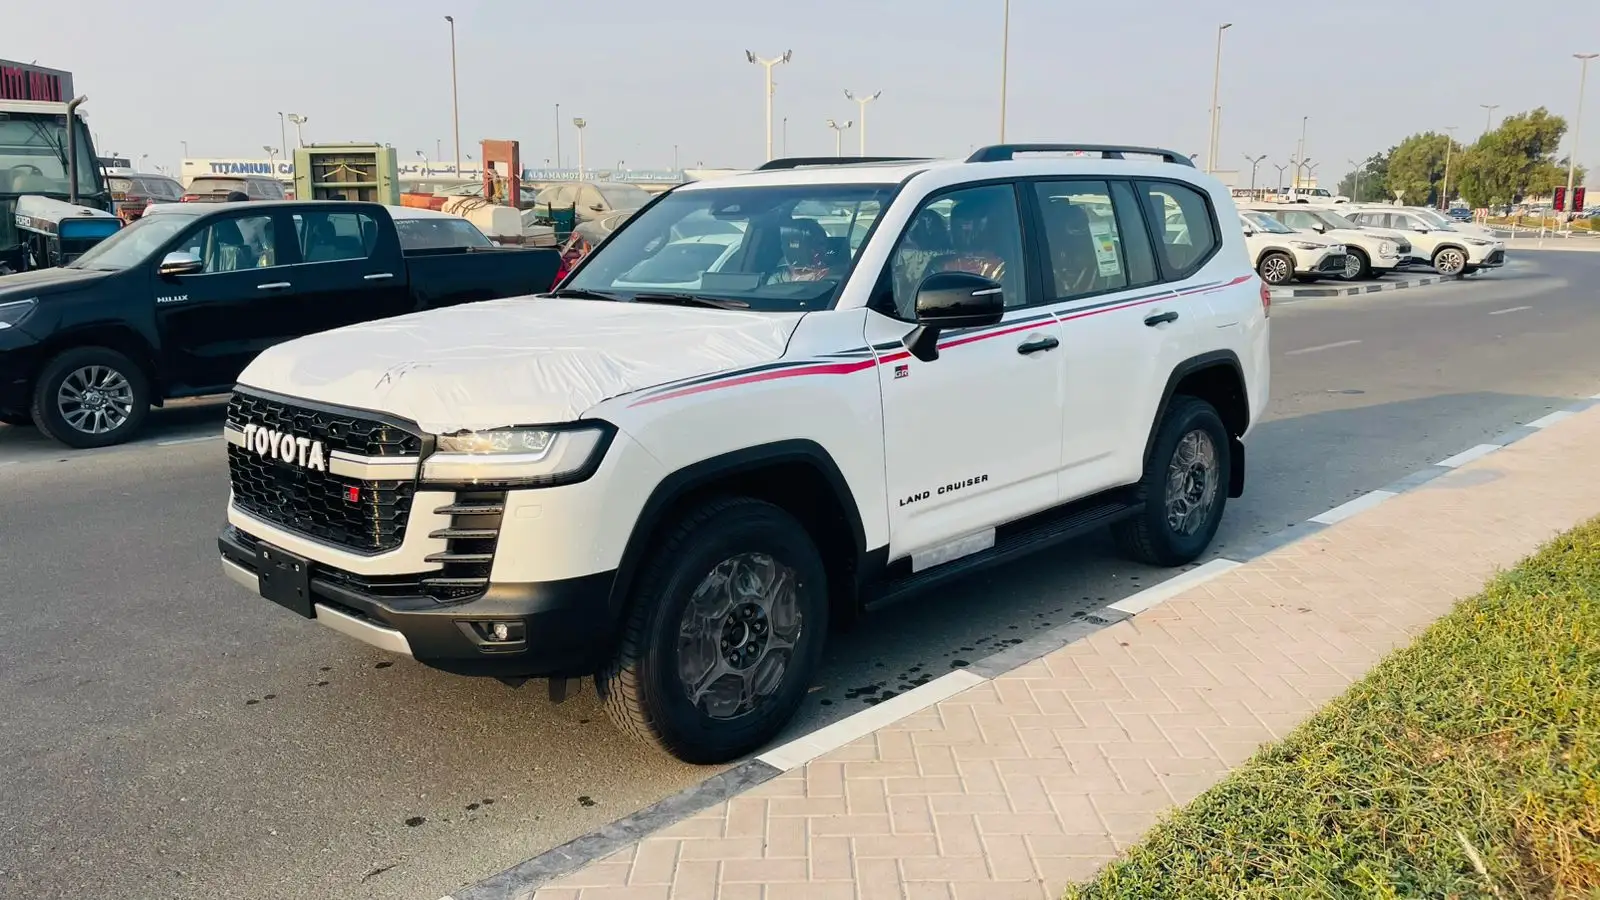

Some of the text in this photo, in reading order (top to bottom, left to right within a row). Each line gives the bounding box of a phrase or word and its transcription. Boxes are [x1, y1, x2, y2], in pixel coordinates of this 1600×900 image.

[16, 215, 30, 227] FORD
[157, 294, 188, 303] HILUX
[895, 368, 908, 379] GR
[243, 423, 325, 471] TOYOTA
[900, 474, 988, 507] LAND CRUISER
